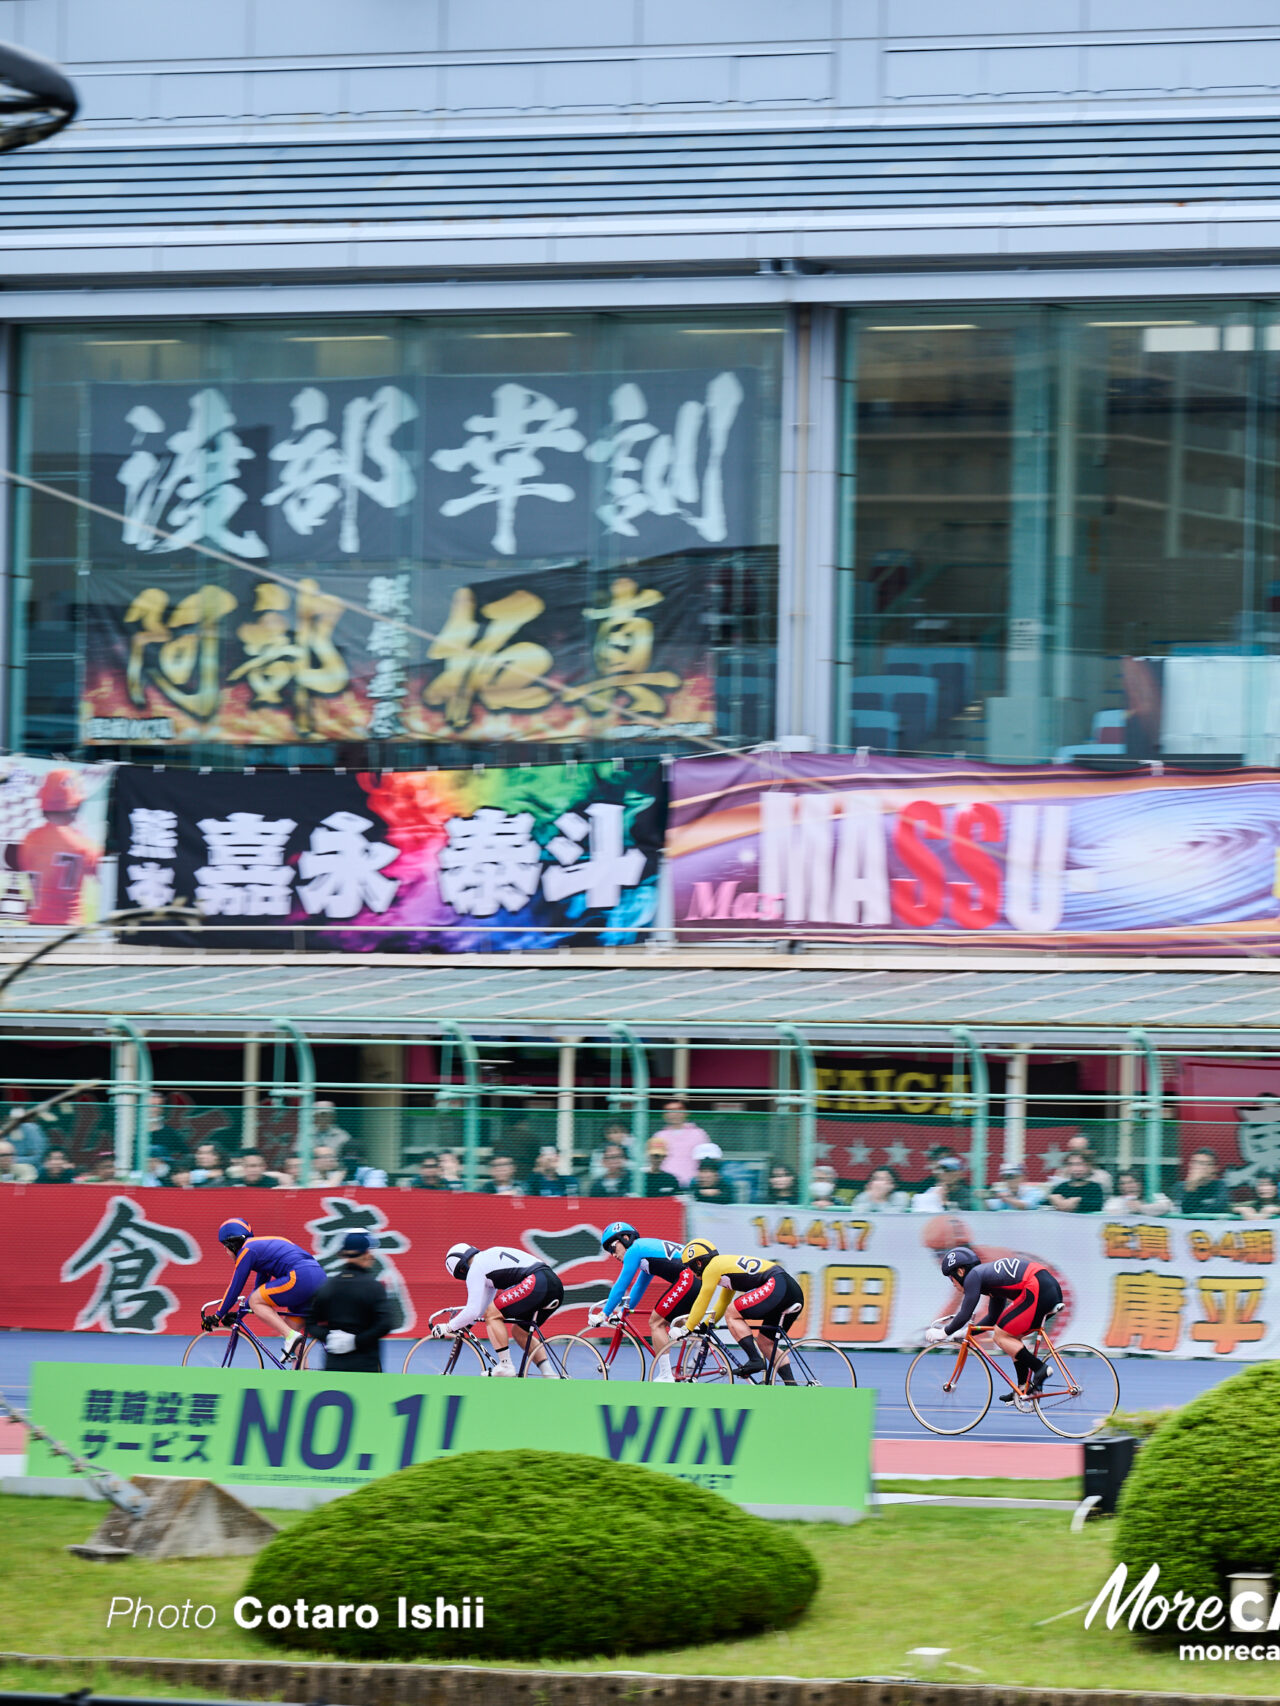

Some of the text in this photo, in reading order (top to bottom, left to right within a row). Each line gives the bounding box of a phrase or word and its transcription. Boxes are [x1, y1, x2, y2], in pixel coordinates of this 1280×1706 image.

[117, 371, 745, 557] 渡部幸訓
[124, 576, 681, 732] 阿部拓真
[127, 808, 178, 907] 熊本
[193, 802, 648, 916] 嘉永泰斗
[757, 791, 1069, 931] MASSU
[685, 881, 783, 921] Max
[612, 1222, 622, 1233] 4
[662, 1240, 684, 1261] 4
[687, 1246, 696, 1259] 5
[736, 1256, 763, 1275] 5
[946, 1251, 957, 1267] 2
[993, 1257, 1021, 1278] 2
[82, 1388, 220, 1427] 競輪投票
[80, 1430, 210, 1463] サービス
[597, 1404, 753, 1467] WIN
